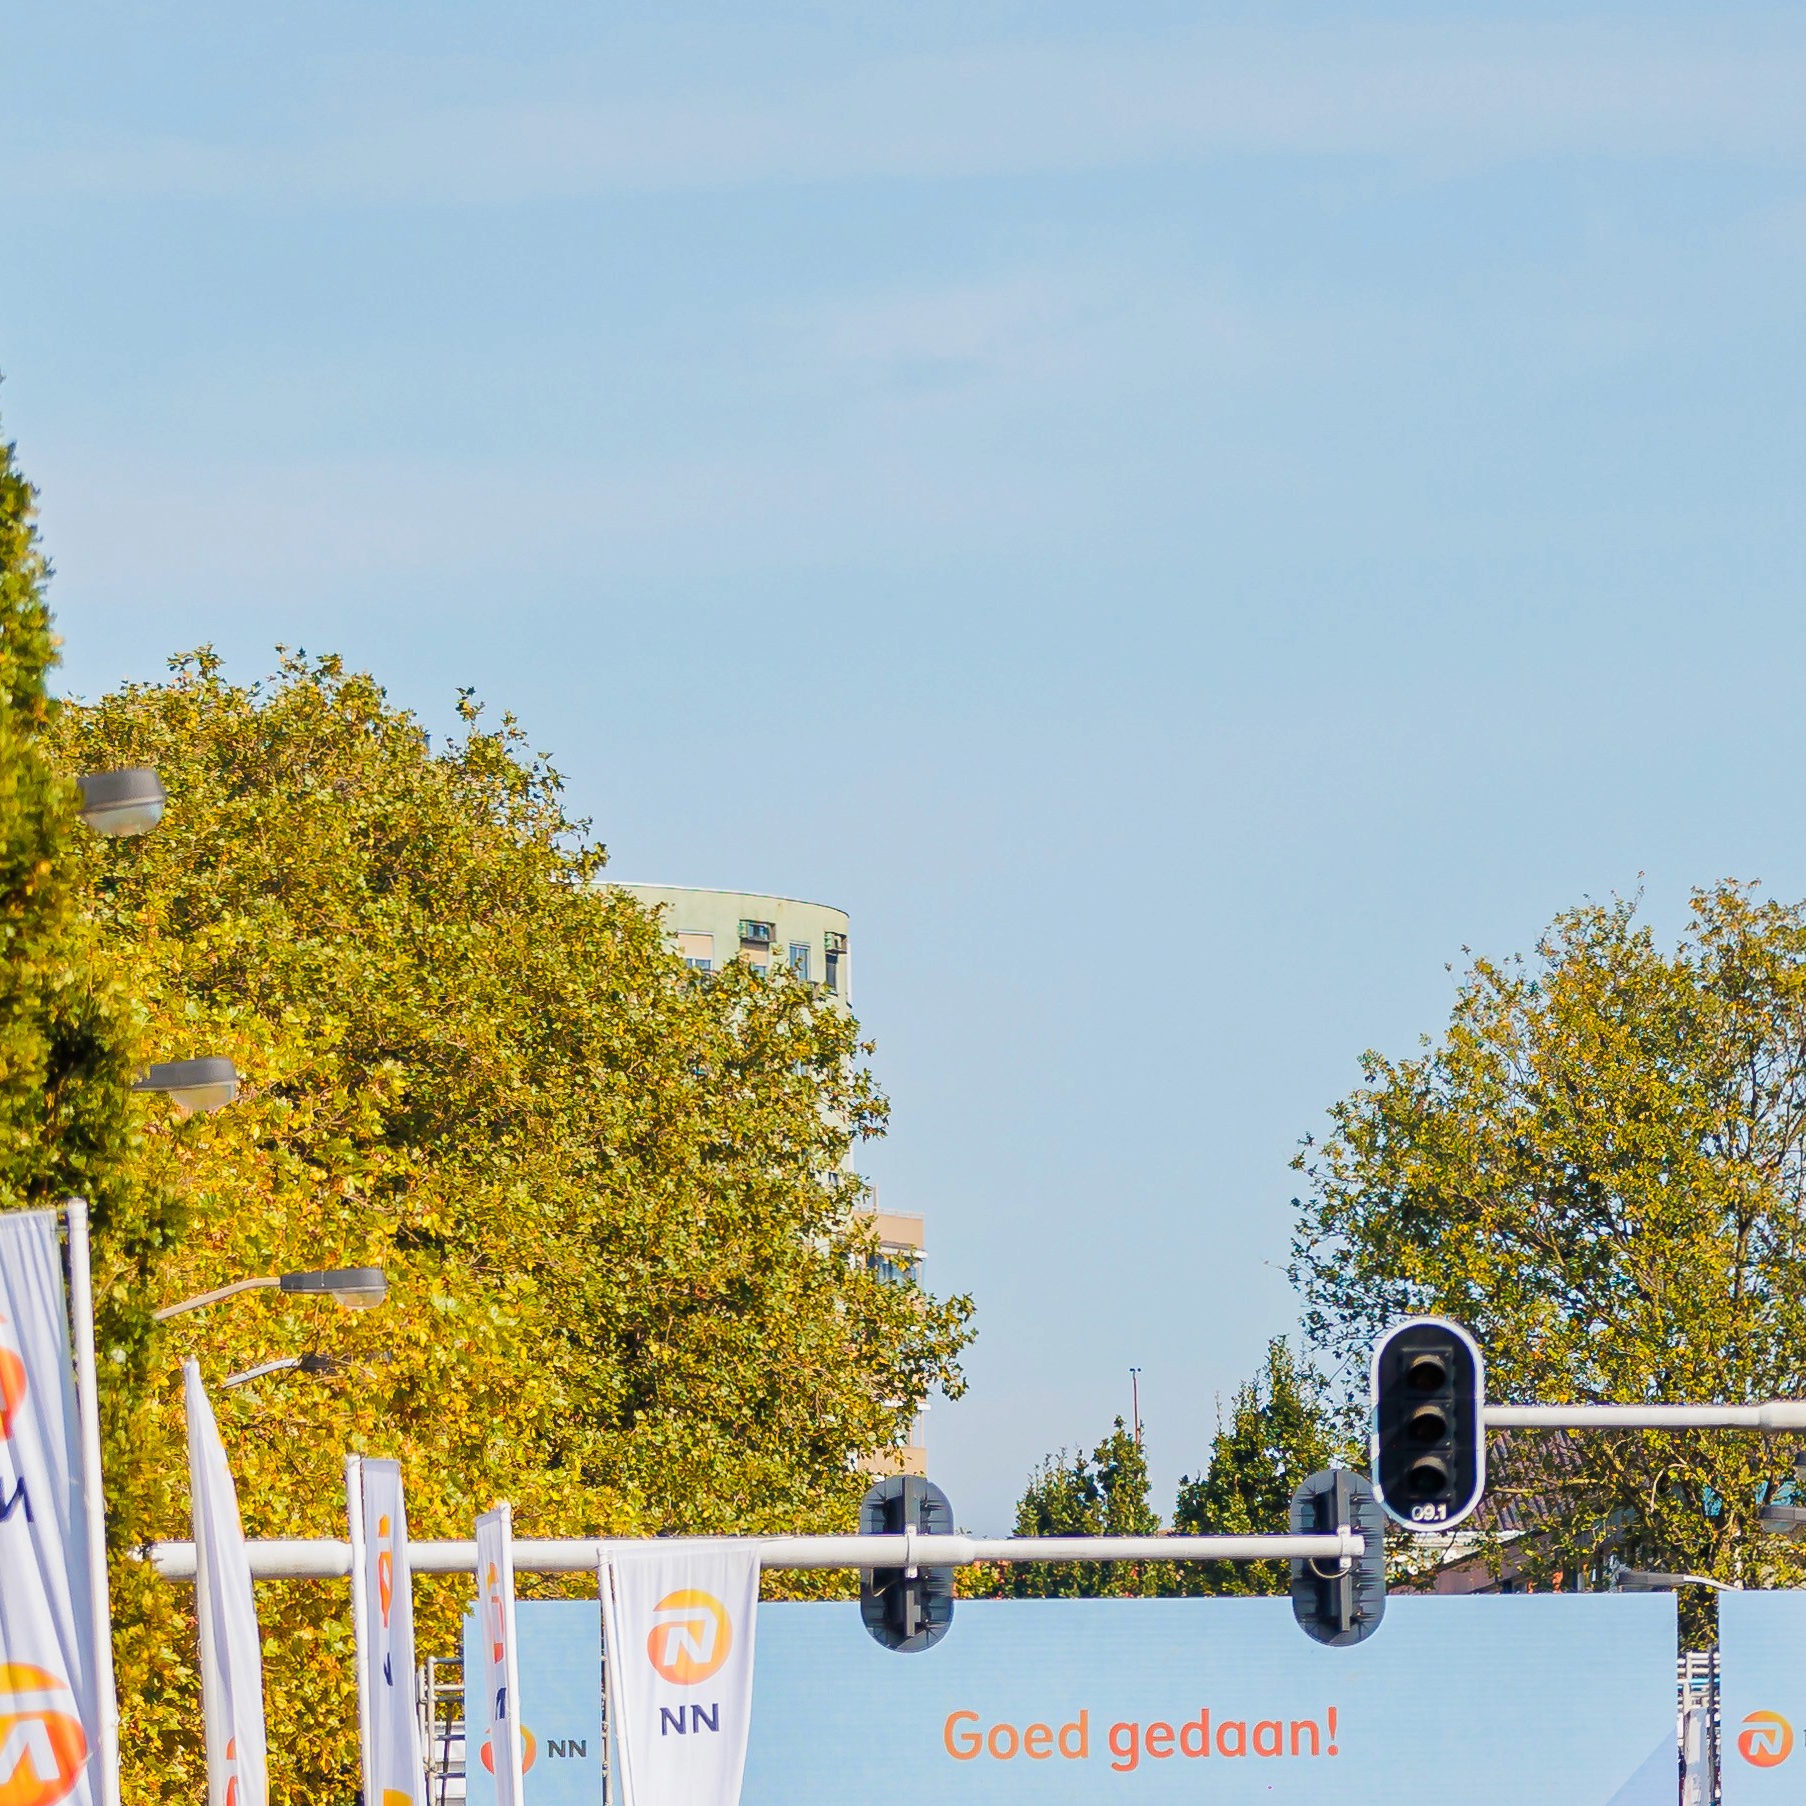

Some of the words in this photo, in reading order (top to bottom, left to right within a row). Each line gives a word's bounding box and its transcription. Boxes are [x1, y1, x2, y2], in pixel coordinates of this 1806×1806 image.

[1411, 1502, 1448, 1522] 09.1
[660, 1703, 721, 1736] NN
[547, 1739, 588, 1759] NN
[942, 1708, 1090, 1762] Goed
[1108, 1706, 1340, 1773] gedaan!
